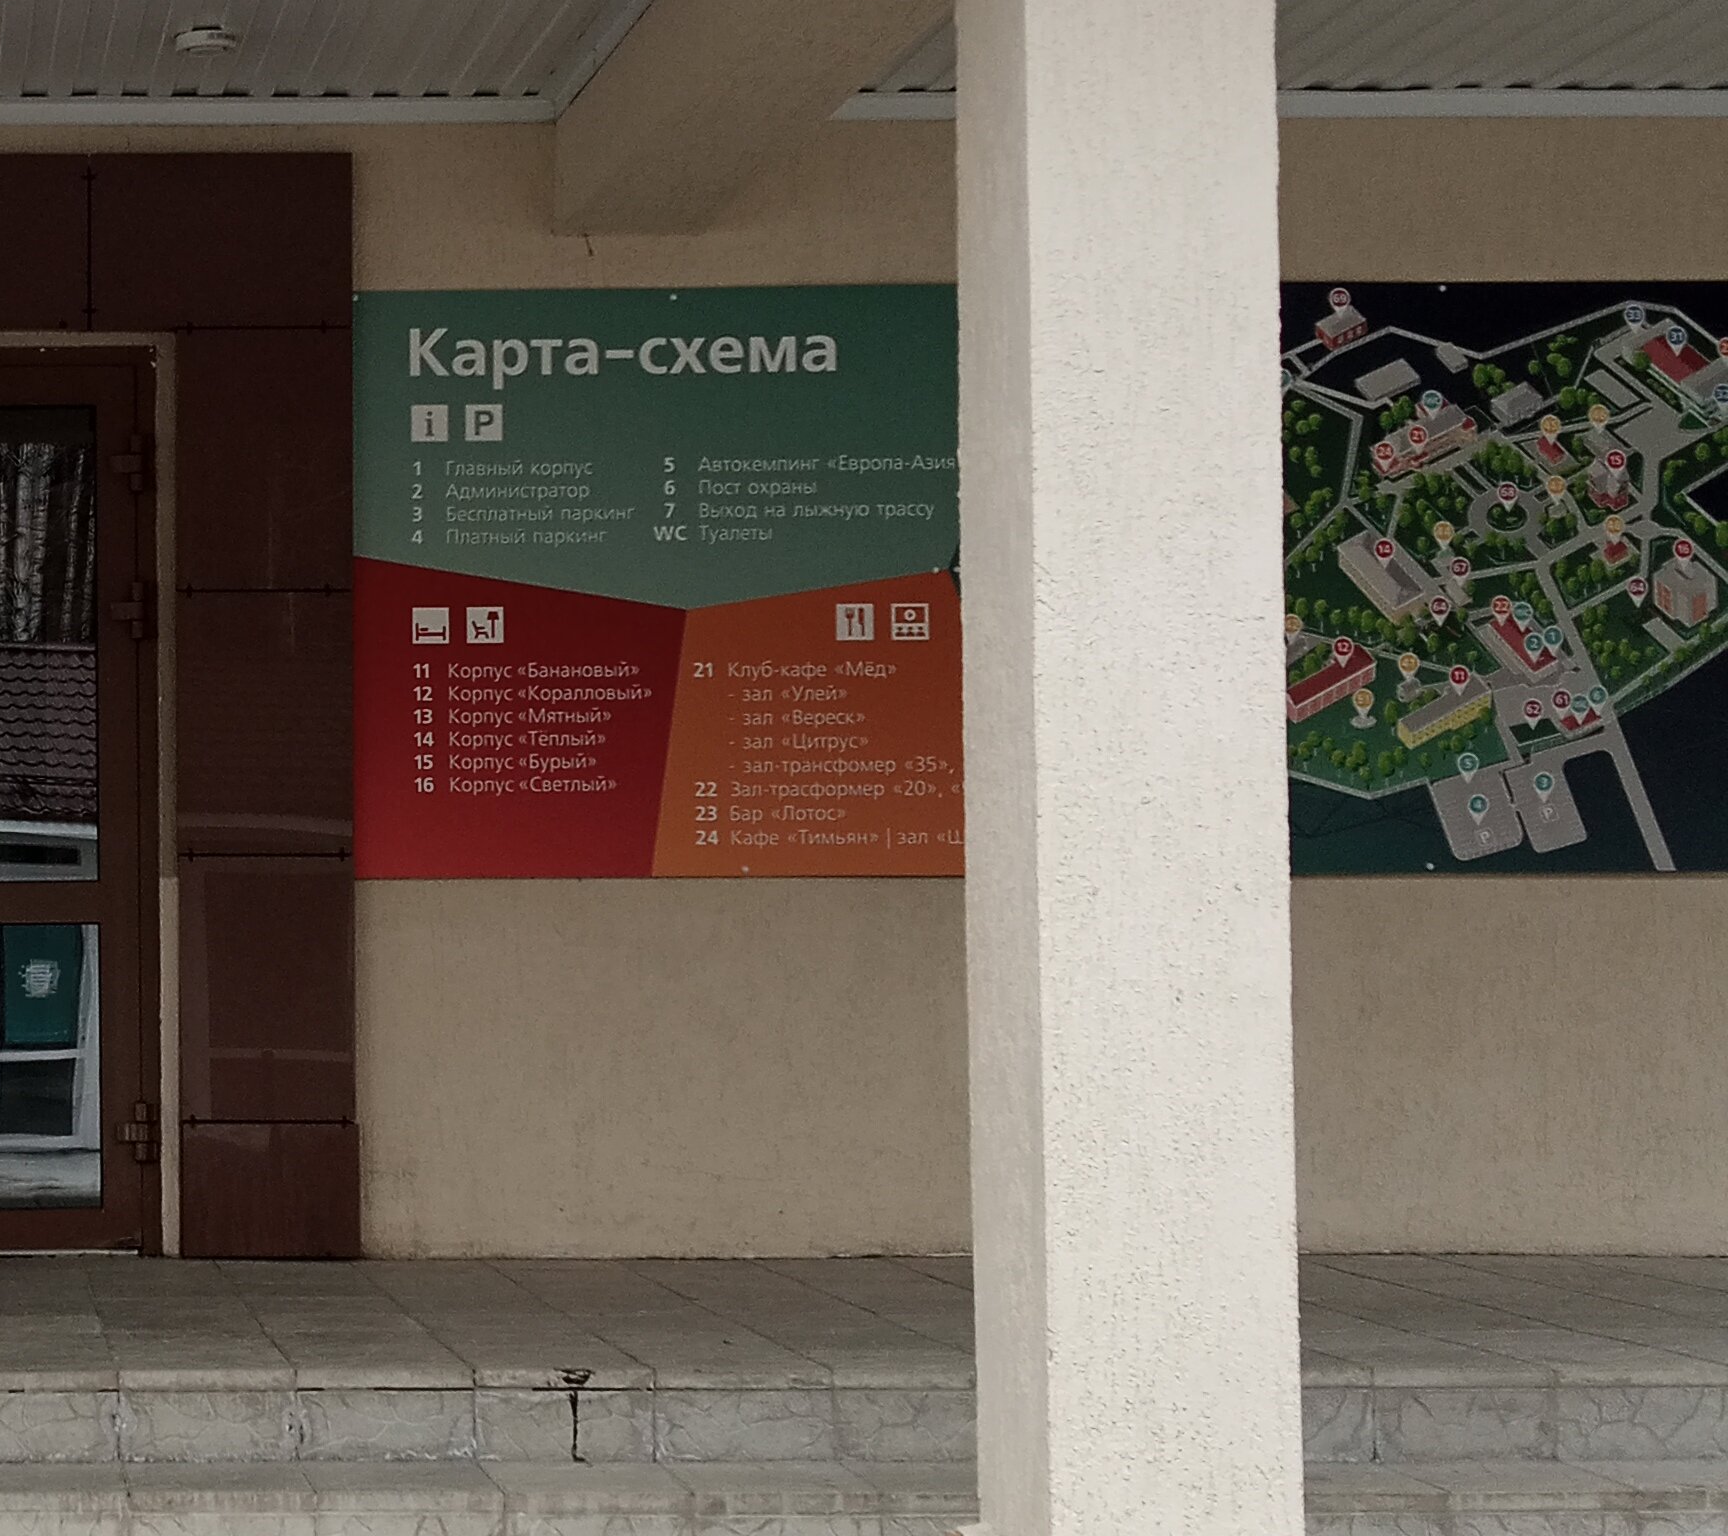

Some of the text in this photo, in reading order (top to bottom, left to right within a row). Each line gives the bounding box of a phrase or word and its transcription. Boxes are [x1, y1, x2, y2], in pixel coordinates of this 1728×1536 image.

[408, 327, 838, 390] Карта-схема
[412, 460, 594, 478] 1 Главный корпус
[663, 457, 675, 473] 5
[698, 457, 820, 473] Автокемпинг
[411, 483, 591, 501] 2 Администратор
[663, 479, 818, 498] 6 Пост охраны
[411, 505, 635, 524] 3 Бесплатный паркинг
[663, 502, 935, 521] 7 Выход на лыжную трассу
[411, 528, 608, 547] 4 Платный паркинг
[653, 524, 773, 544] WC Туалеты
[412, 662, 640, 682] 11 Корпус «Банановый»
[693, 662, 715, 678] 21
[727, 661, 827, 682] Клуб-кафе
[412, 684, 653, 706] 12 Корпус «Коралловый»
[741, 689, 773, 702] зал
[782, 685, 848, 702] «Улей»
[412, 706, 612, 727] 13 Корпус «Мятный»
[742, 713, 773, 726] зал
[781, 710, 865, 728] «Вереск»
[413, 730, 606, 750] 14 Корпус «Тёплый»
[742, 737, 773, 750] зал
[781, 734, 869, 752] «Цитрус»
[413, 752, 597, 774] 15 Корпус «Бурый»
[414, 775, 617, 796] 16 Корпус «Светлый»
[694, 782, 718, 798] 22
[694, 805, 846, 825] 23 Бар «Лотос»
[694, 830, 719, 846] 24
[730, 829, 779, 847] Кафе
[787, 829, 879, 846] «Тимьян»
[897, 832, 929, 845] зал
